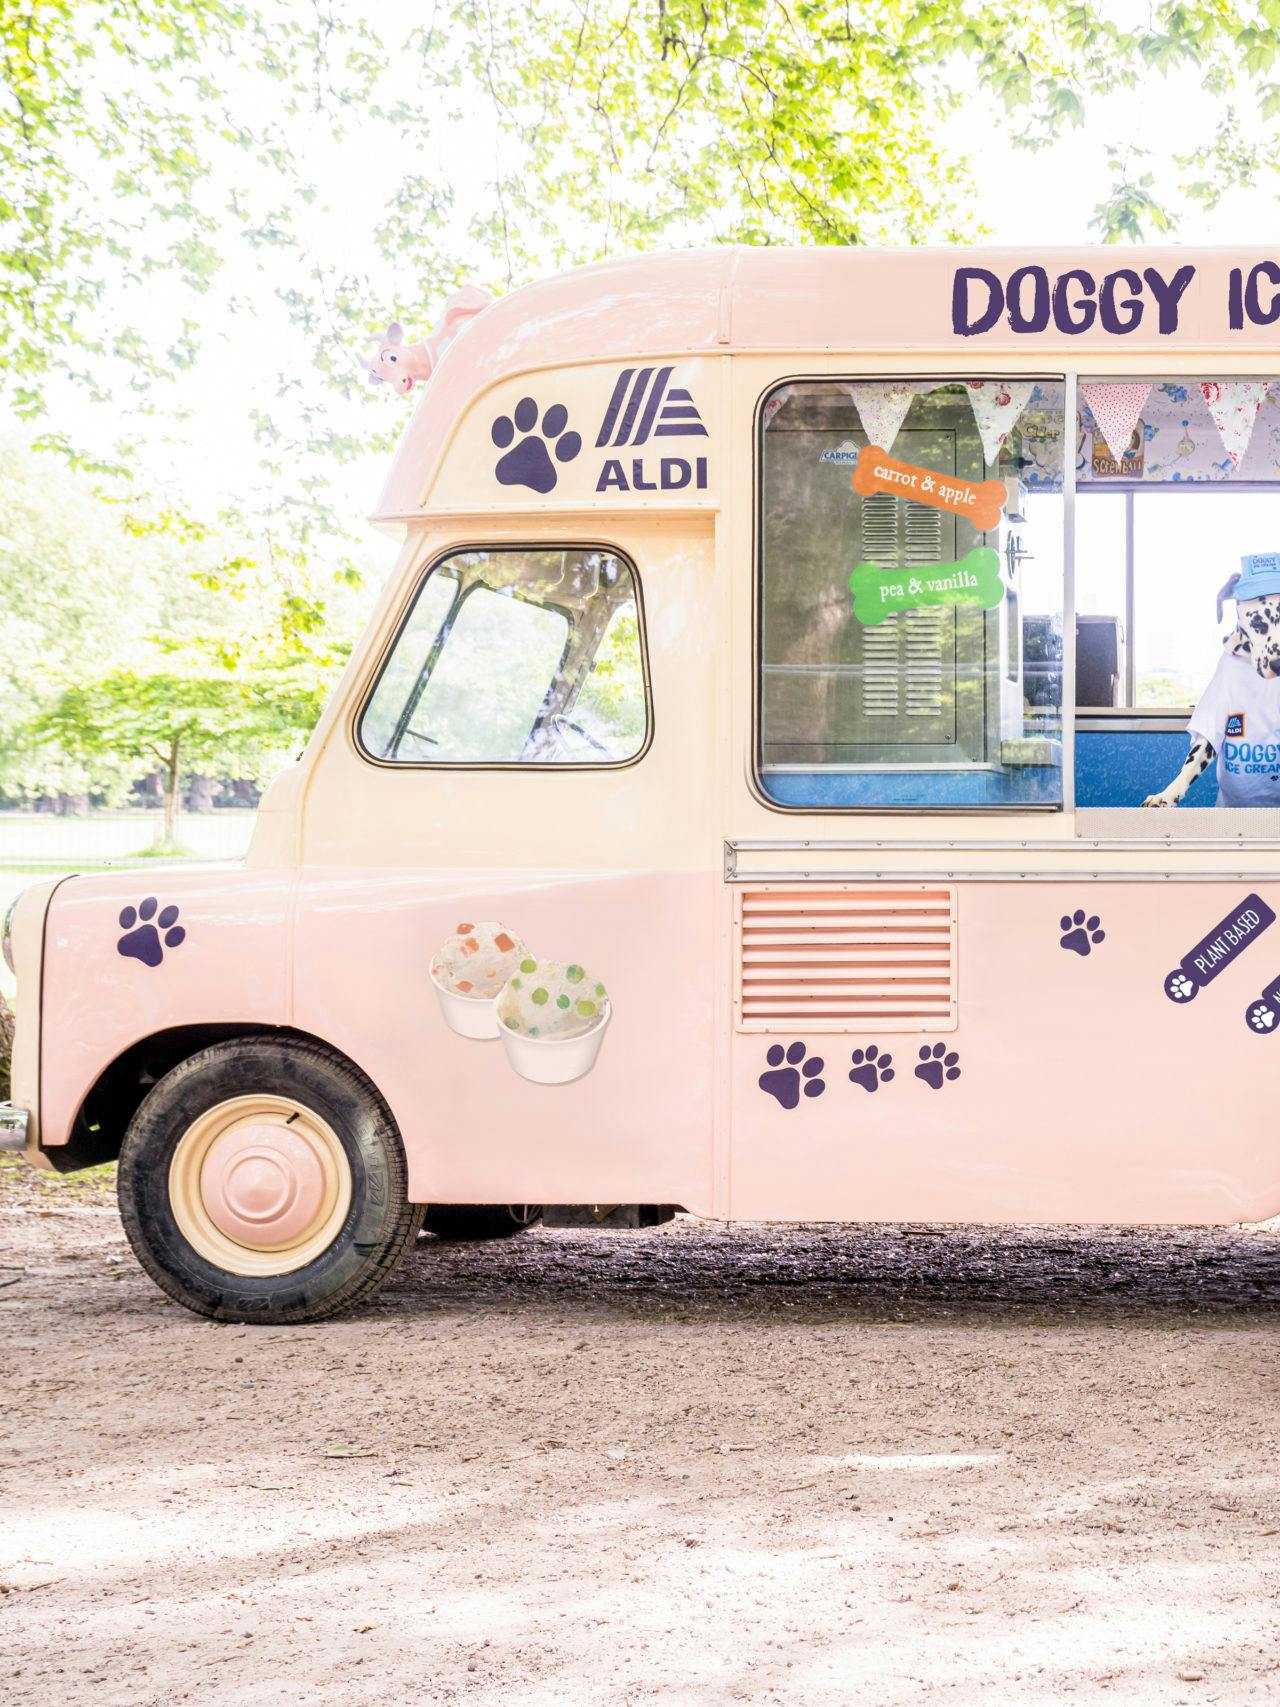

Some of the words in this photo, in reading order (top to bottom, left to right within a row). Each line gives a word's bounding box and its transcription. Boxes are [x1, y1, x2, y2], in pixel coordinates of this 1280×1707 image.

[952, 266, 1196, 337] DOGGY
[596, 458, 708, 492] ALDI
[874, 466, 918, 488] carrot
[921, 475, 937, 493] &
[938, 485, 976, 505] apple
[880, 584, 904, 603] pea
[908, 578, 923, 595] &
[926, 570, 979, 592] vanilla
[1225, 760, 1240, 775] ICE
[1193, 936, 1231, 975] PLANT
[1223, 909, 1260, 946] BASED
